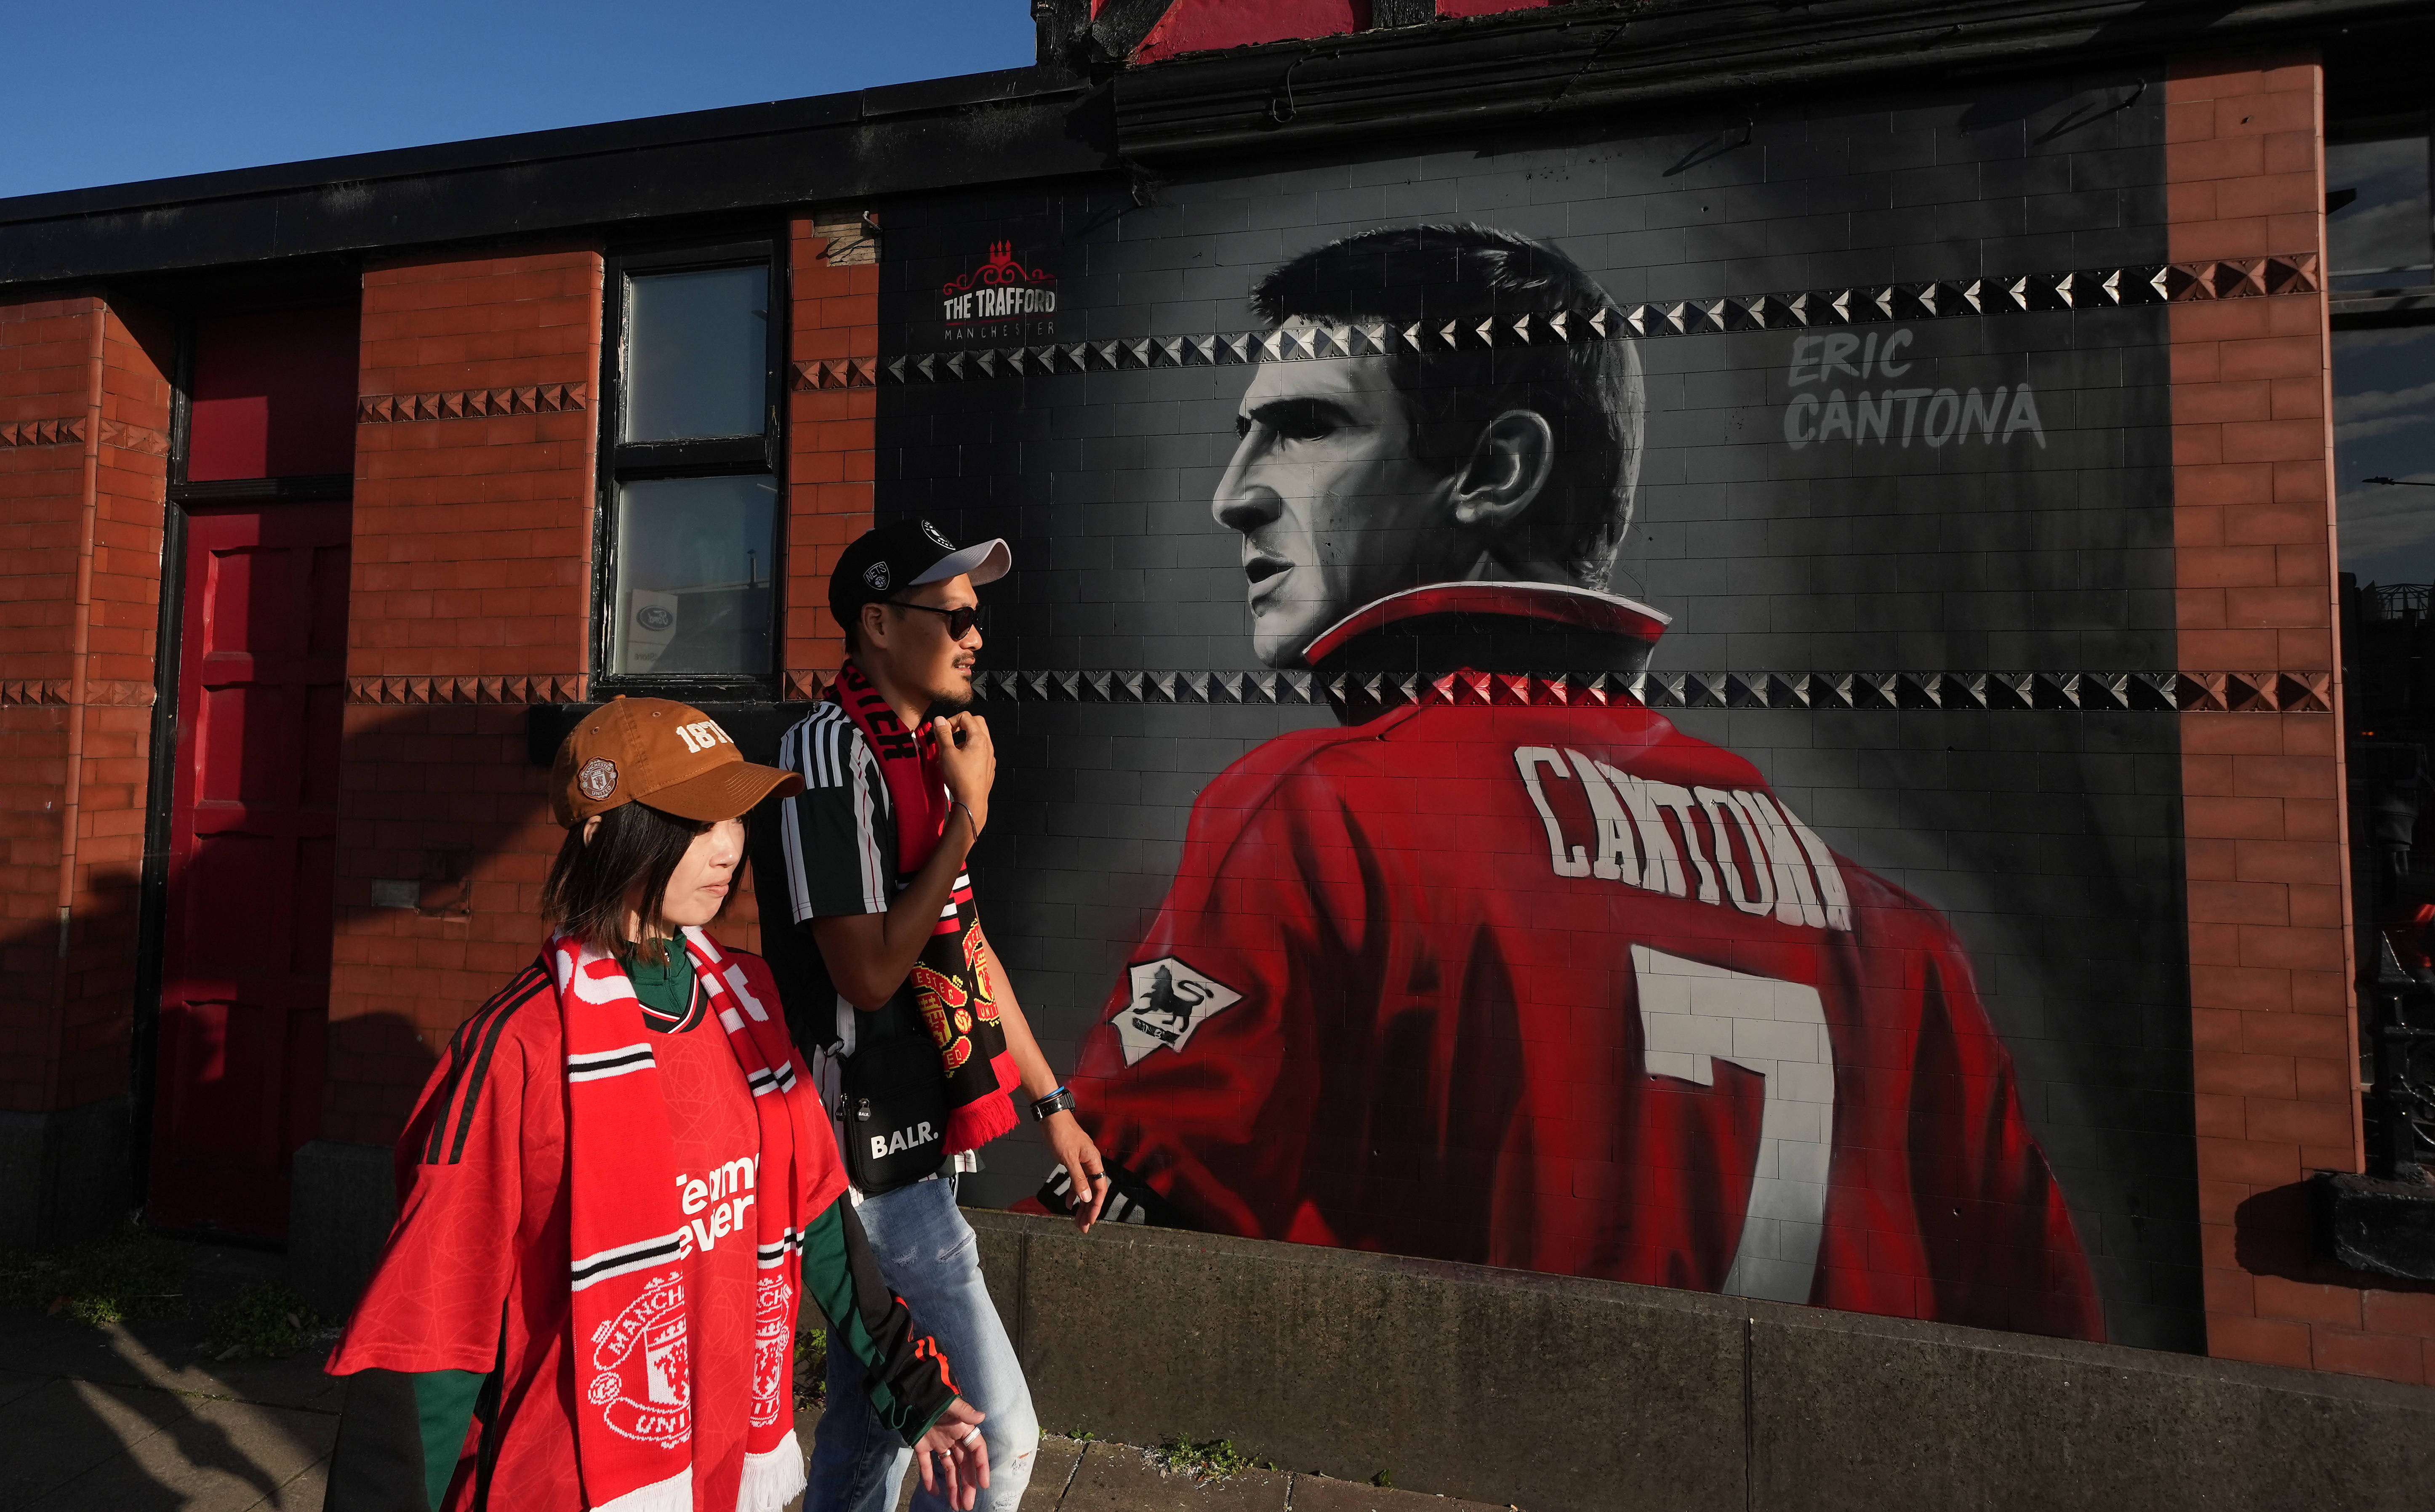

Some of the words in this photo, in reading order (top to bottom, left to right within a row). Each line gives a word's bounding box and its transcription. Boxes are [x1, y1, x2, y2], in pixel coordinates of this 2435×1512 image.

[944, 293, 972, 320] THE
[976, 287, 1055, 317] TRAFFORD
[945, 322, 1054, 340] MANCHESTER
[1788, 328, 1913, 387] ERIC
[1784, 383, 2046, 450] CANTONA
[866, 564, 887, 582] NETS
[584, 762, 611, 778] MANCHESTER
[592, 785, 611, 795] UNITED
[871, 1121, 938, 1159] BALR.
[1630, 944, 1836, 1305] 7
